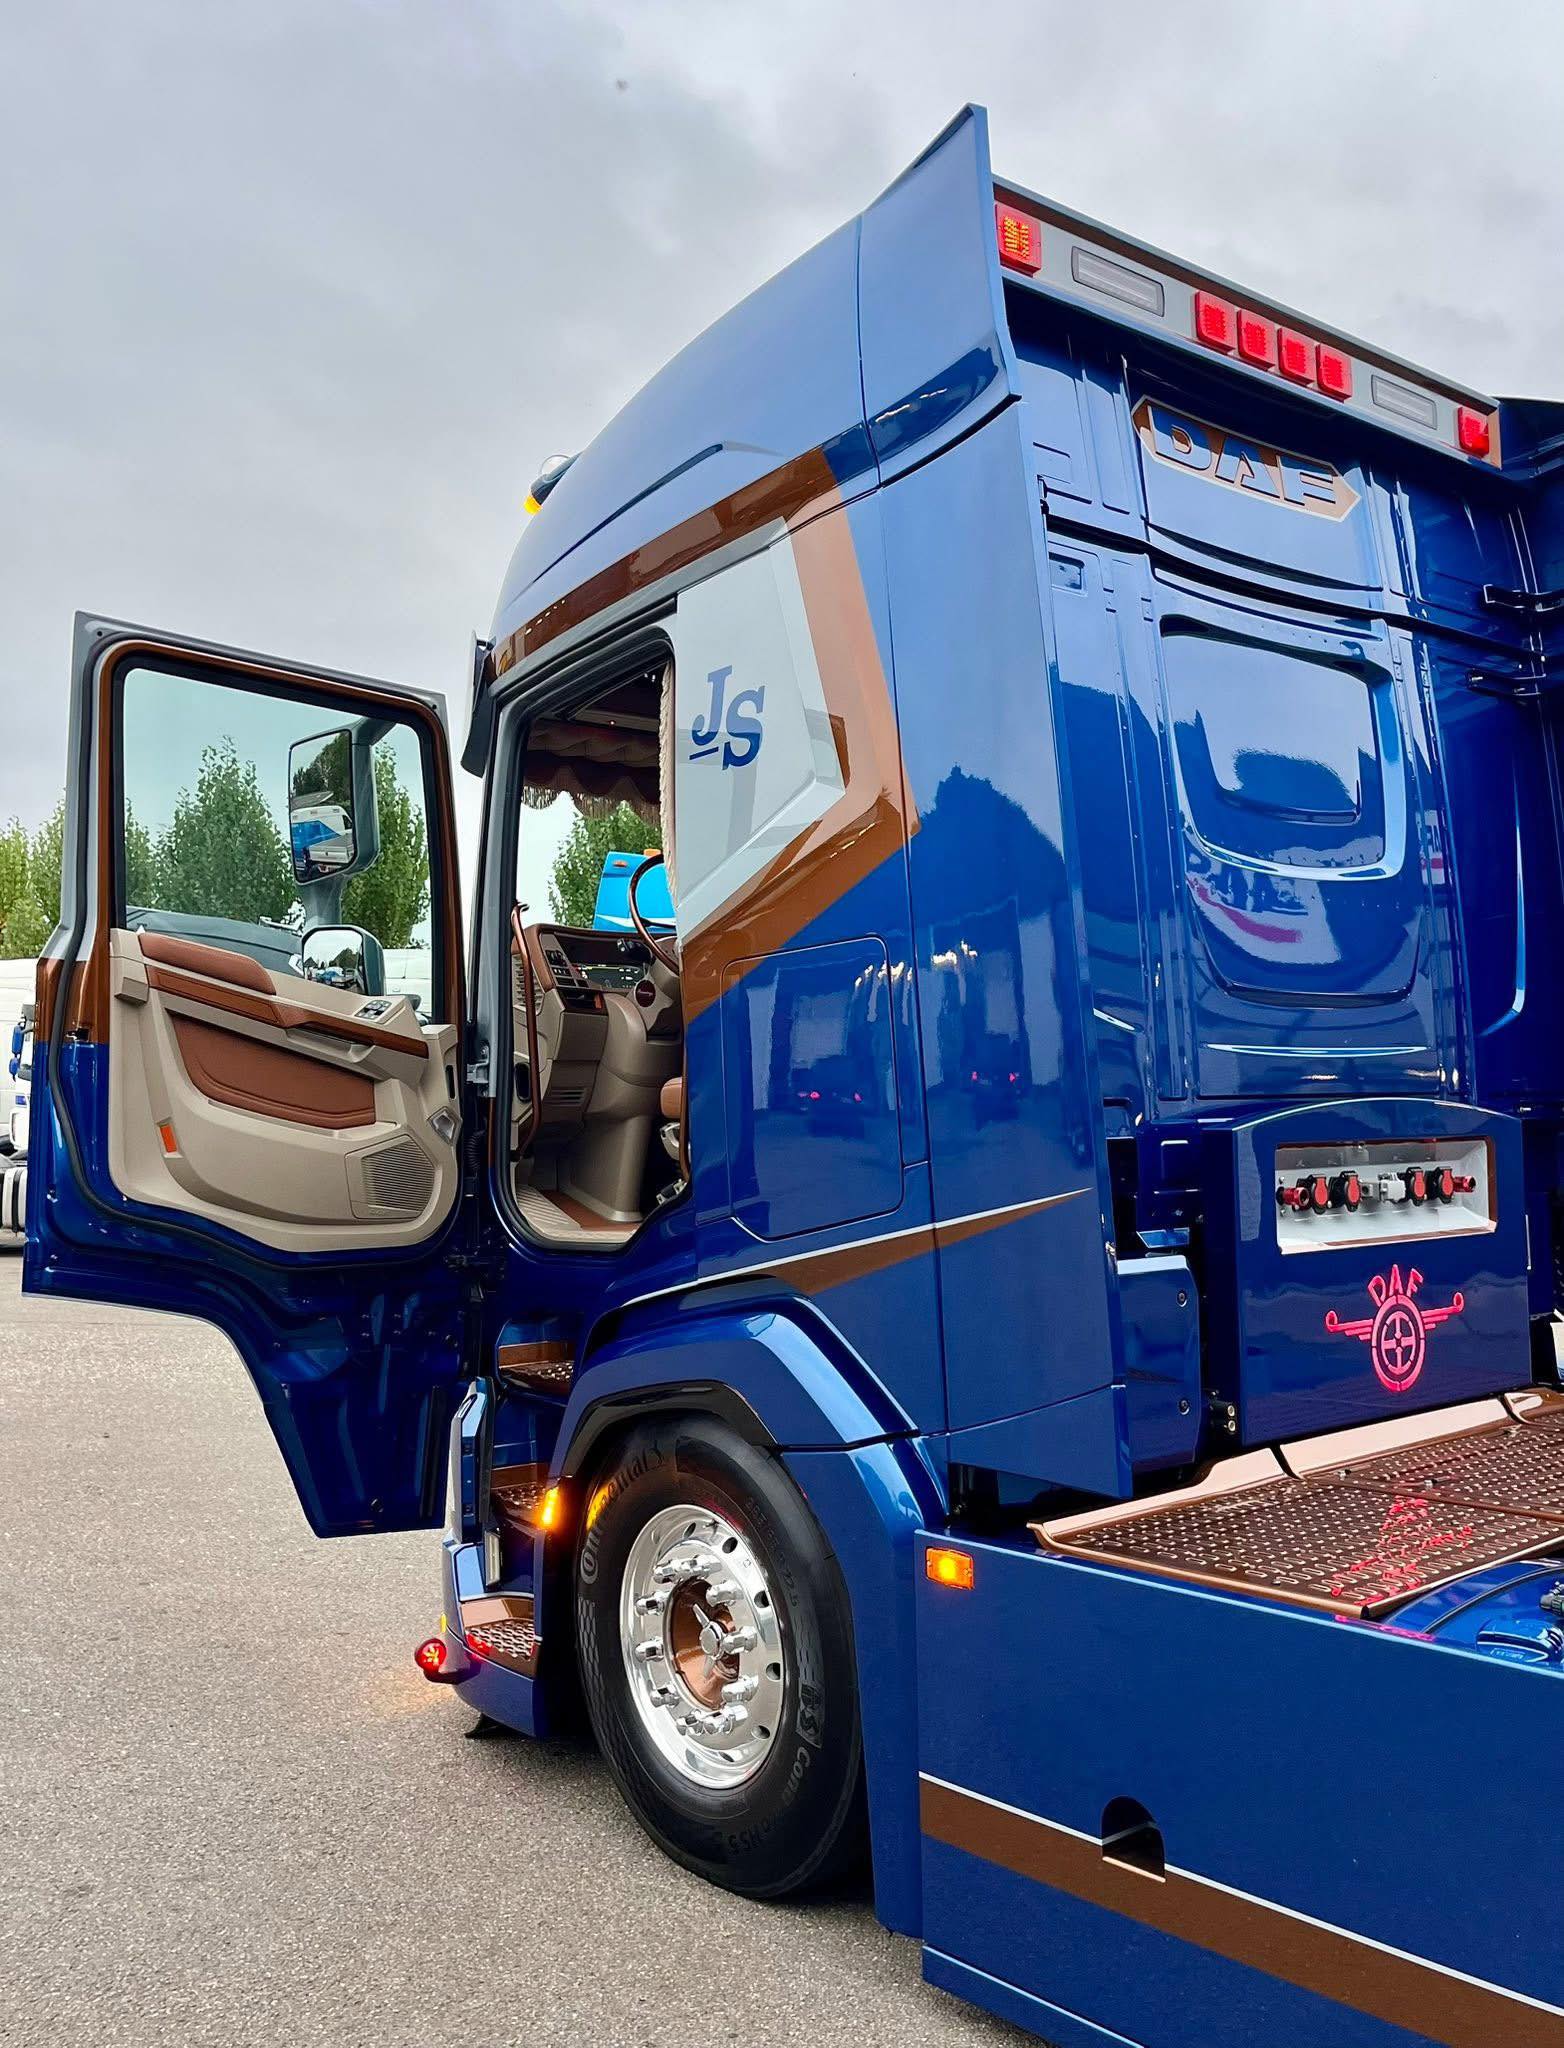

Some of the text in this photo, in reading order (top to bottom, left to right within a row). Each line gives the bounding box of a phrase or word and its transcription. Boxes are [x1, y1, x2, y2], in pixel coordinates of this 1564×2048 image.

[1147, 404, 1336, 506] DAF
[690, 665, 766, 770] JS
[1367, 1264, 1424, 1307] DAF
[580, 1447, 649, 1585] Connental
